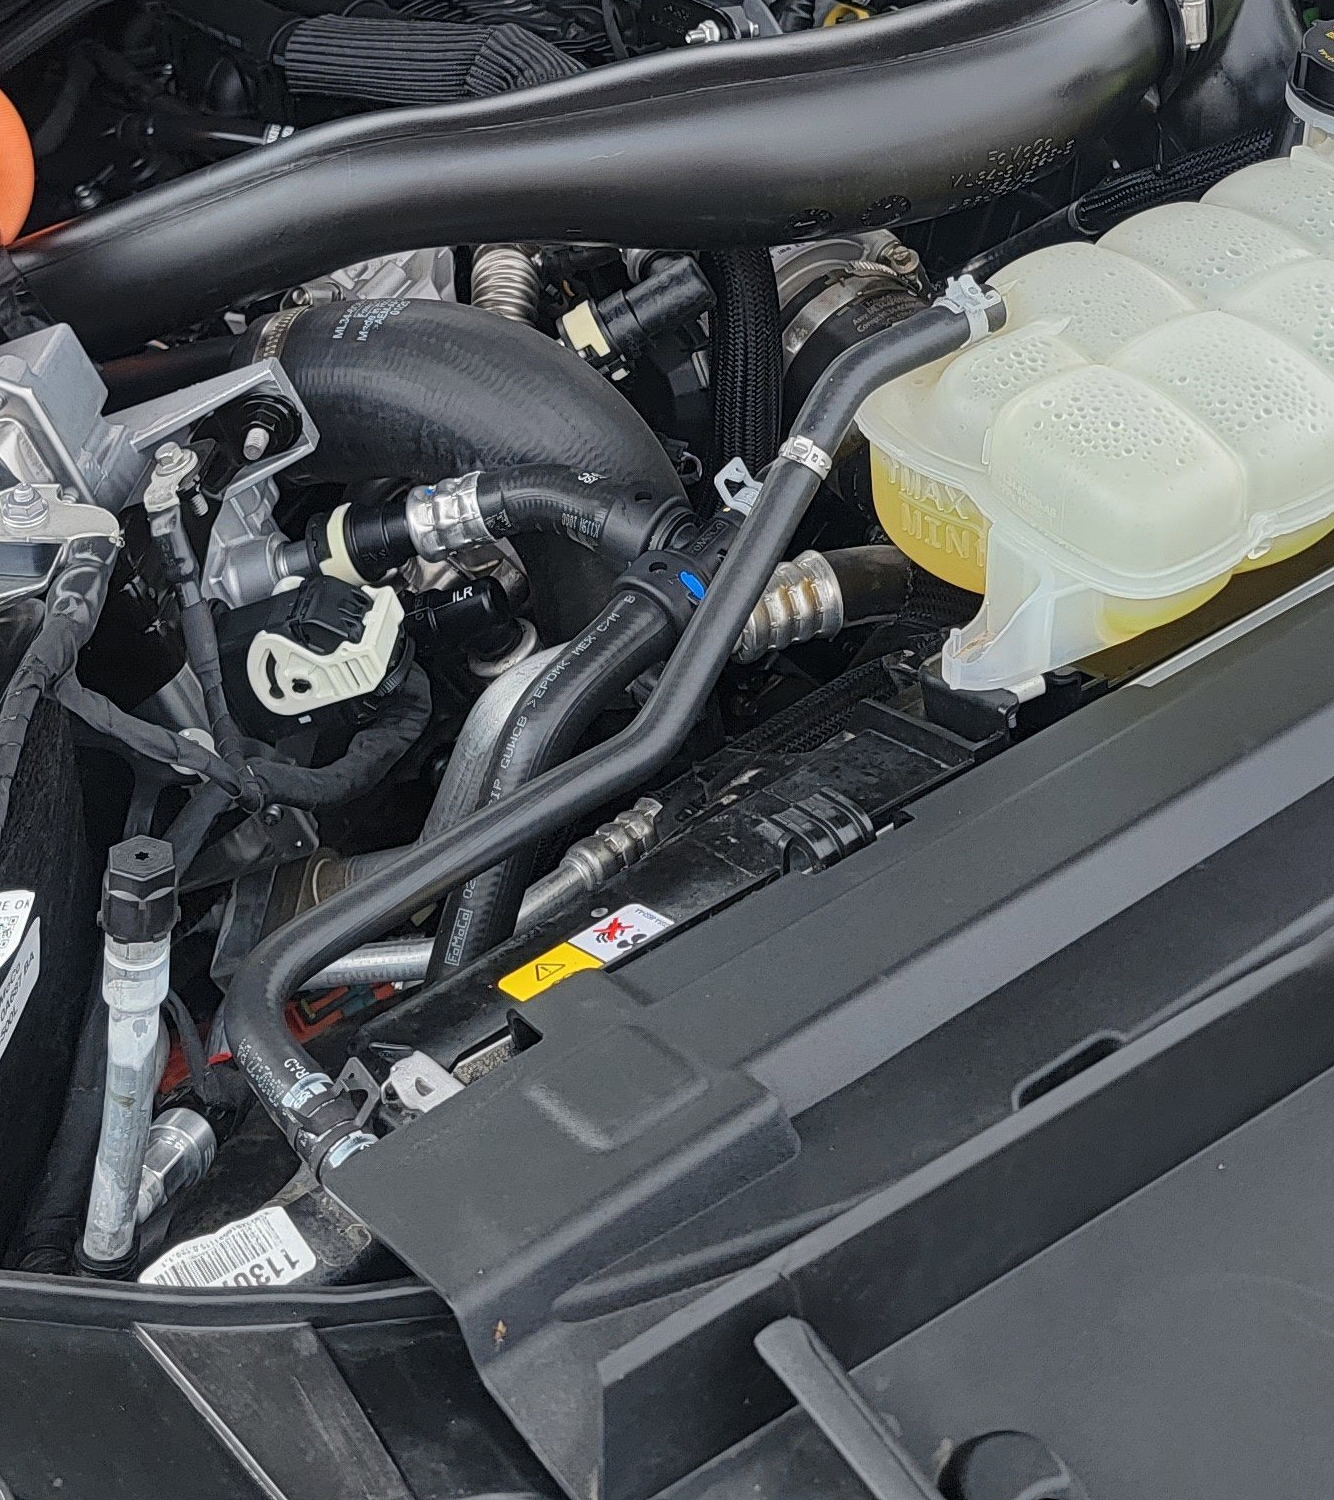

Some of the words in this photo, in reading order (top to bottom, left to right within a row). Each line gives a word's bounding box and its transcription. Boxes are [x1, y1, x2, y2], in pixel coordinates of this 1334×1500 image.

[895, 502, 975, 559] MIN
[571, 634, 596, 656] MEX
[448, 911, 470, 963] FoMoCo
[23, 951, 35, 976] BA
